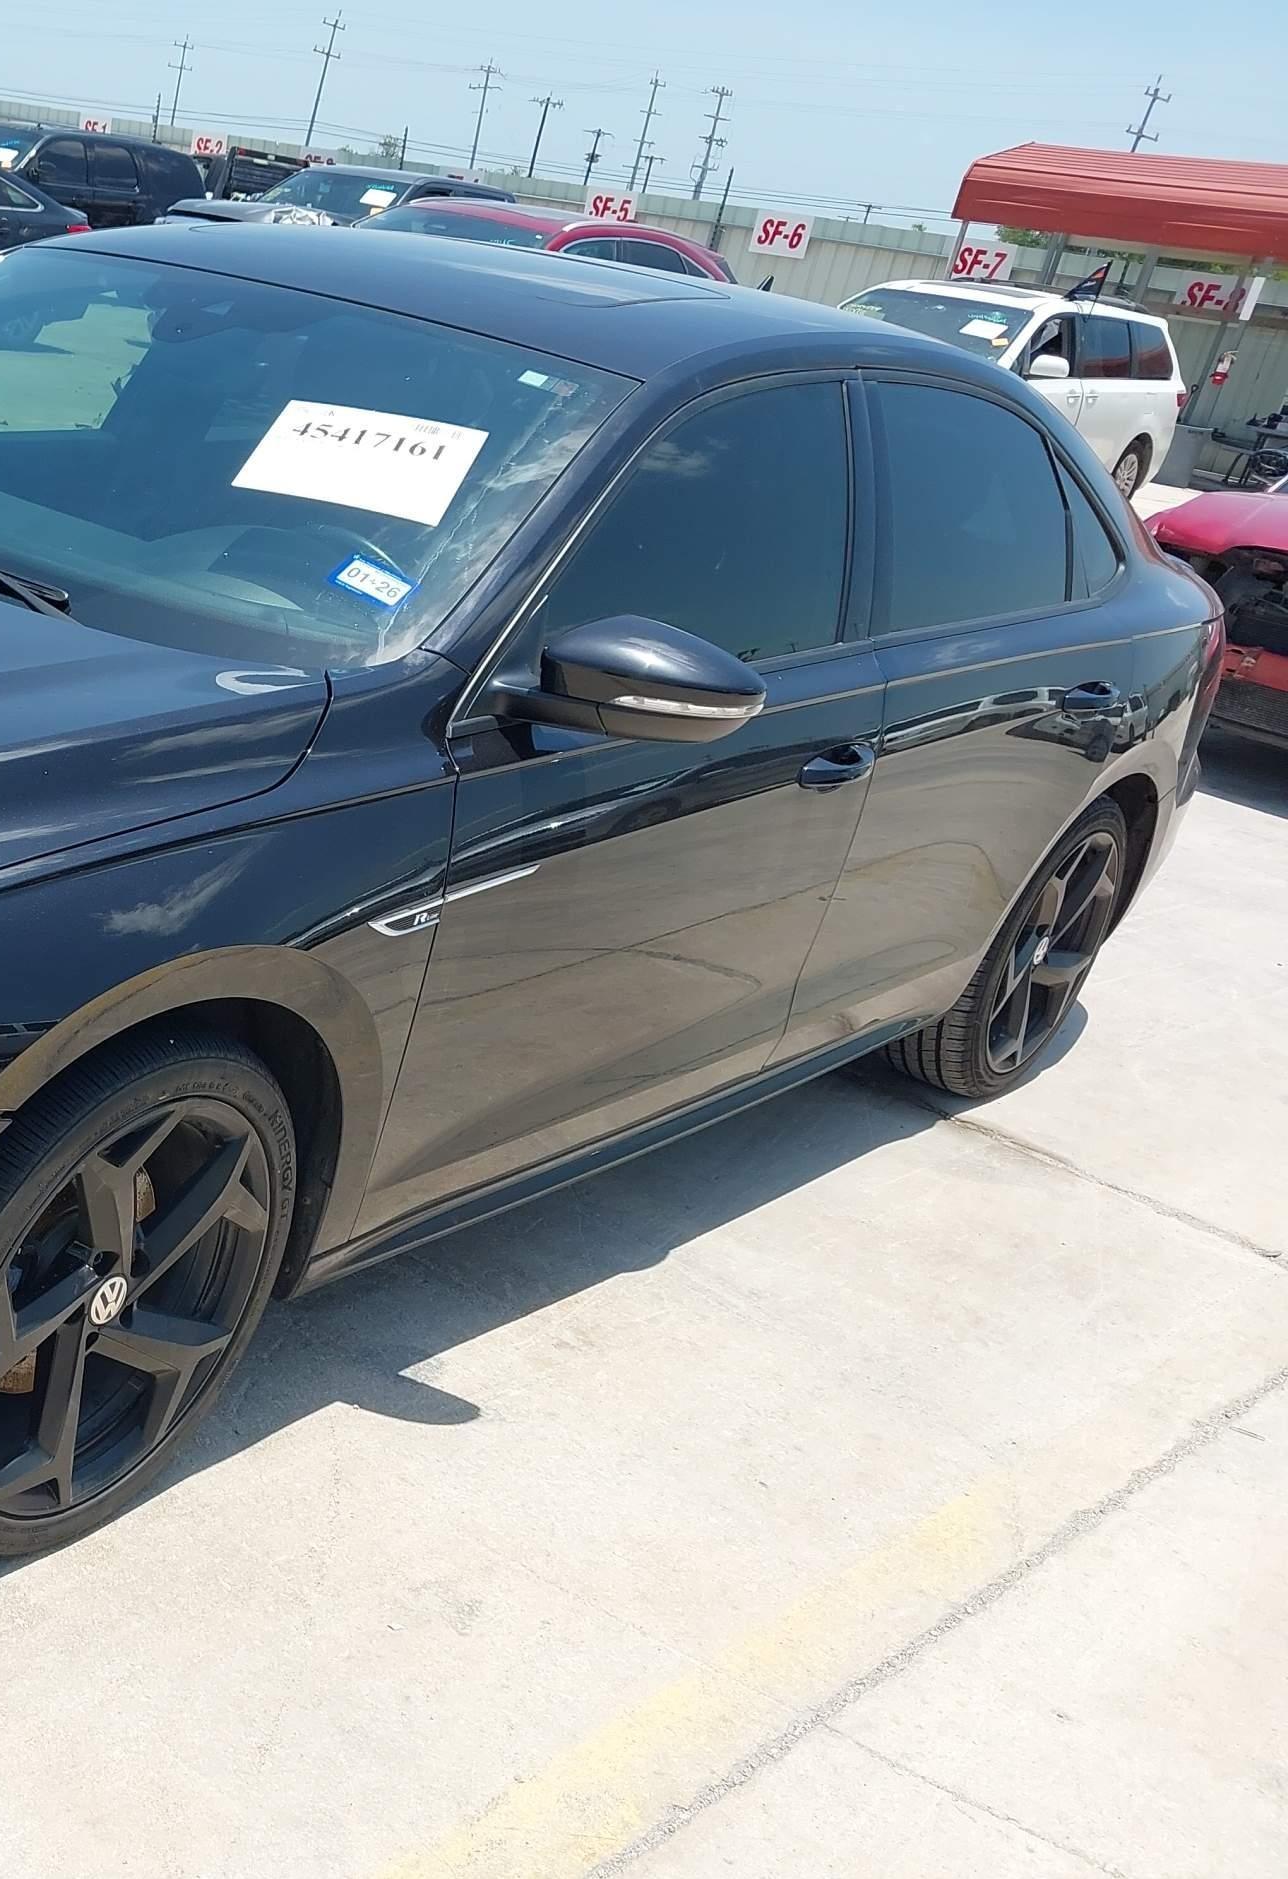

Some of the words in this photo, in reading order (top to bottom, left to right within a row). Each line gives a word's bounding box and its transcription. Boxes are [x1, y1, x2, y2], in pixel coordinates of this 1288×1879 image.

[85, 120, 107, 133] SF1
[196, 137, 224, 154] SF-2
[589, 195, 633, 222] SF-5
[757, 218, 807, 250] SF-6
[953, 246, 1009, 279] SF-7
[1181, 281, 1246, 312] SF-8
[292, 422, 446, 460] 45417161
